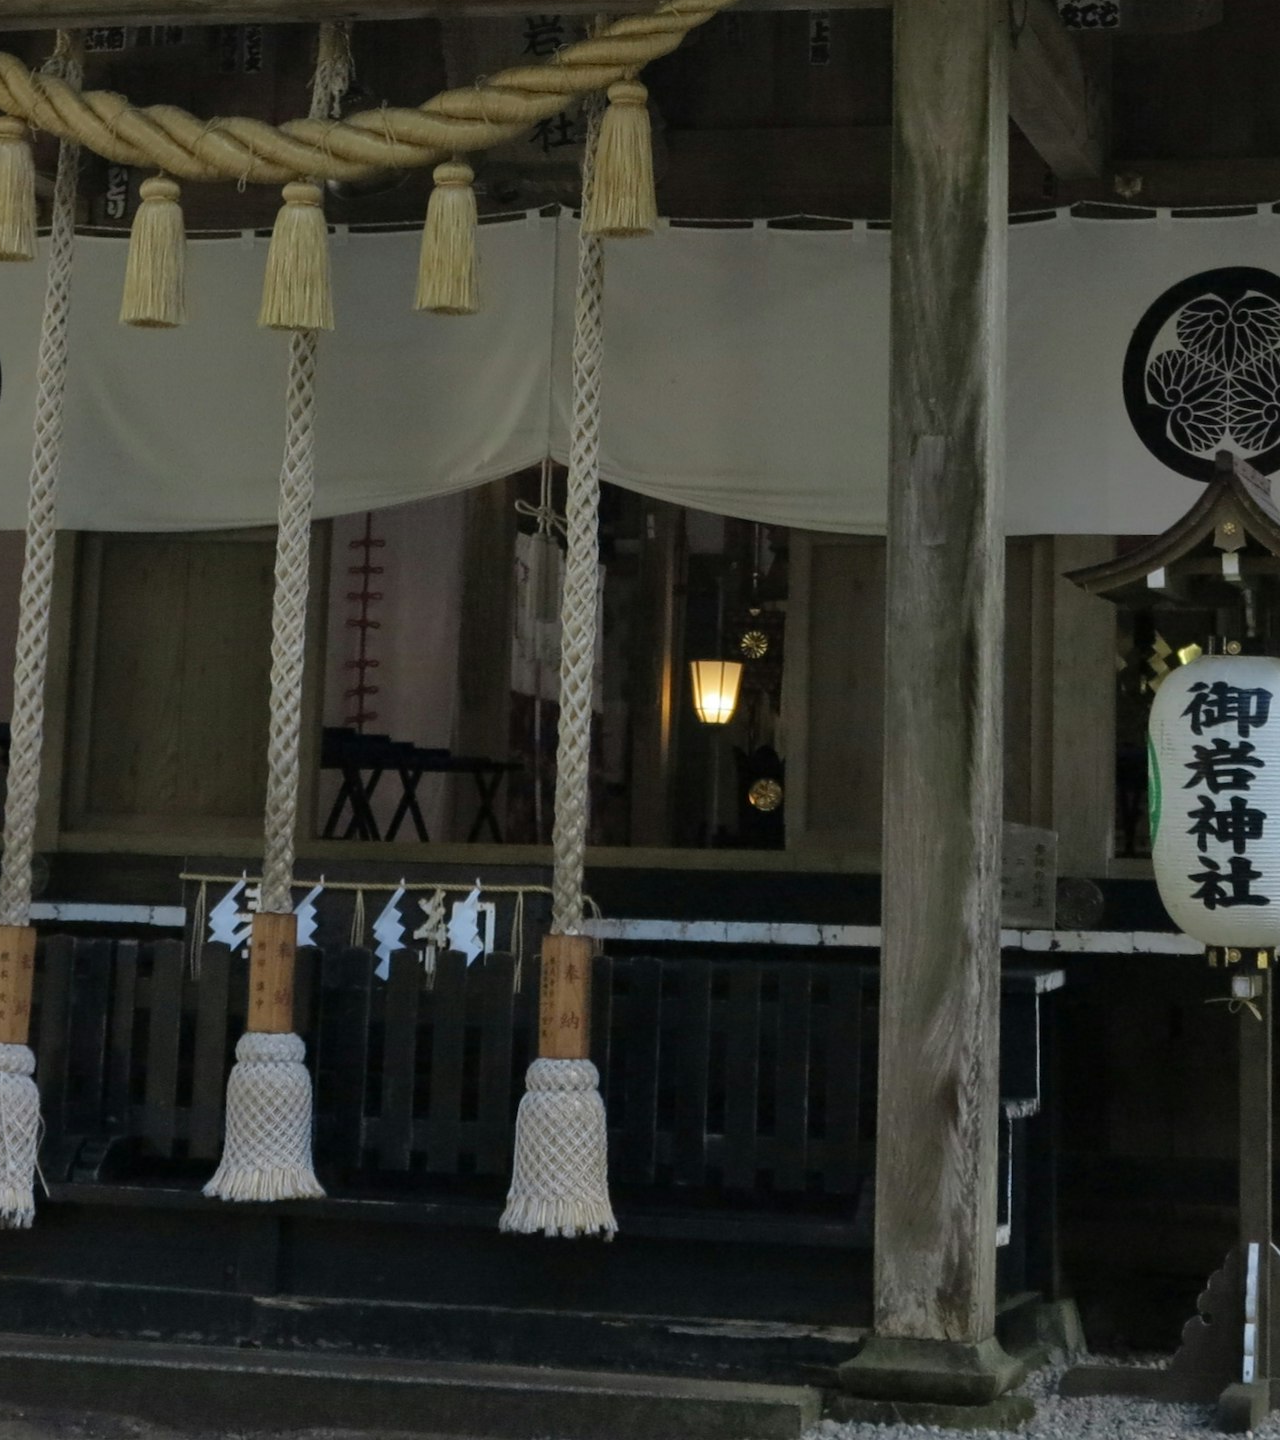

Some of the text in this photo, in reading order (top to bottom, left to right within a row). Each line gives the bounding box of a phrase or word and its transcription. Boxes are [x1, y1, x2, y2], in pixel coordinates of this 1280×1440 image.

[1181, 680, 1274, 910] 御岩神社
[560, 963, 580, 1030] 奉納
